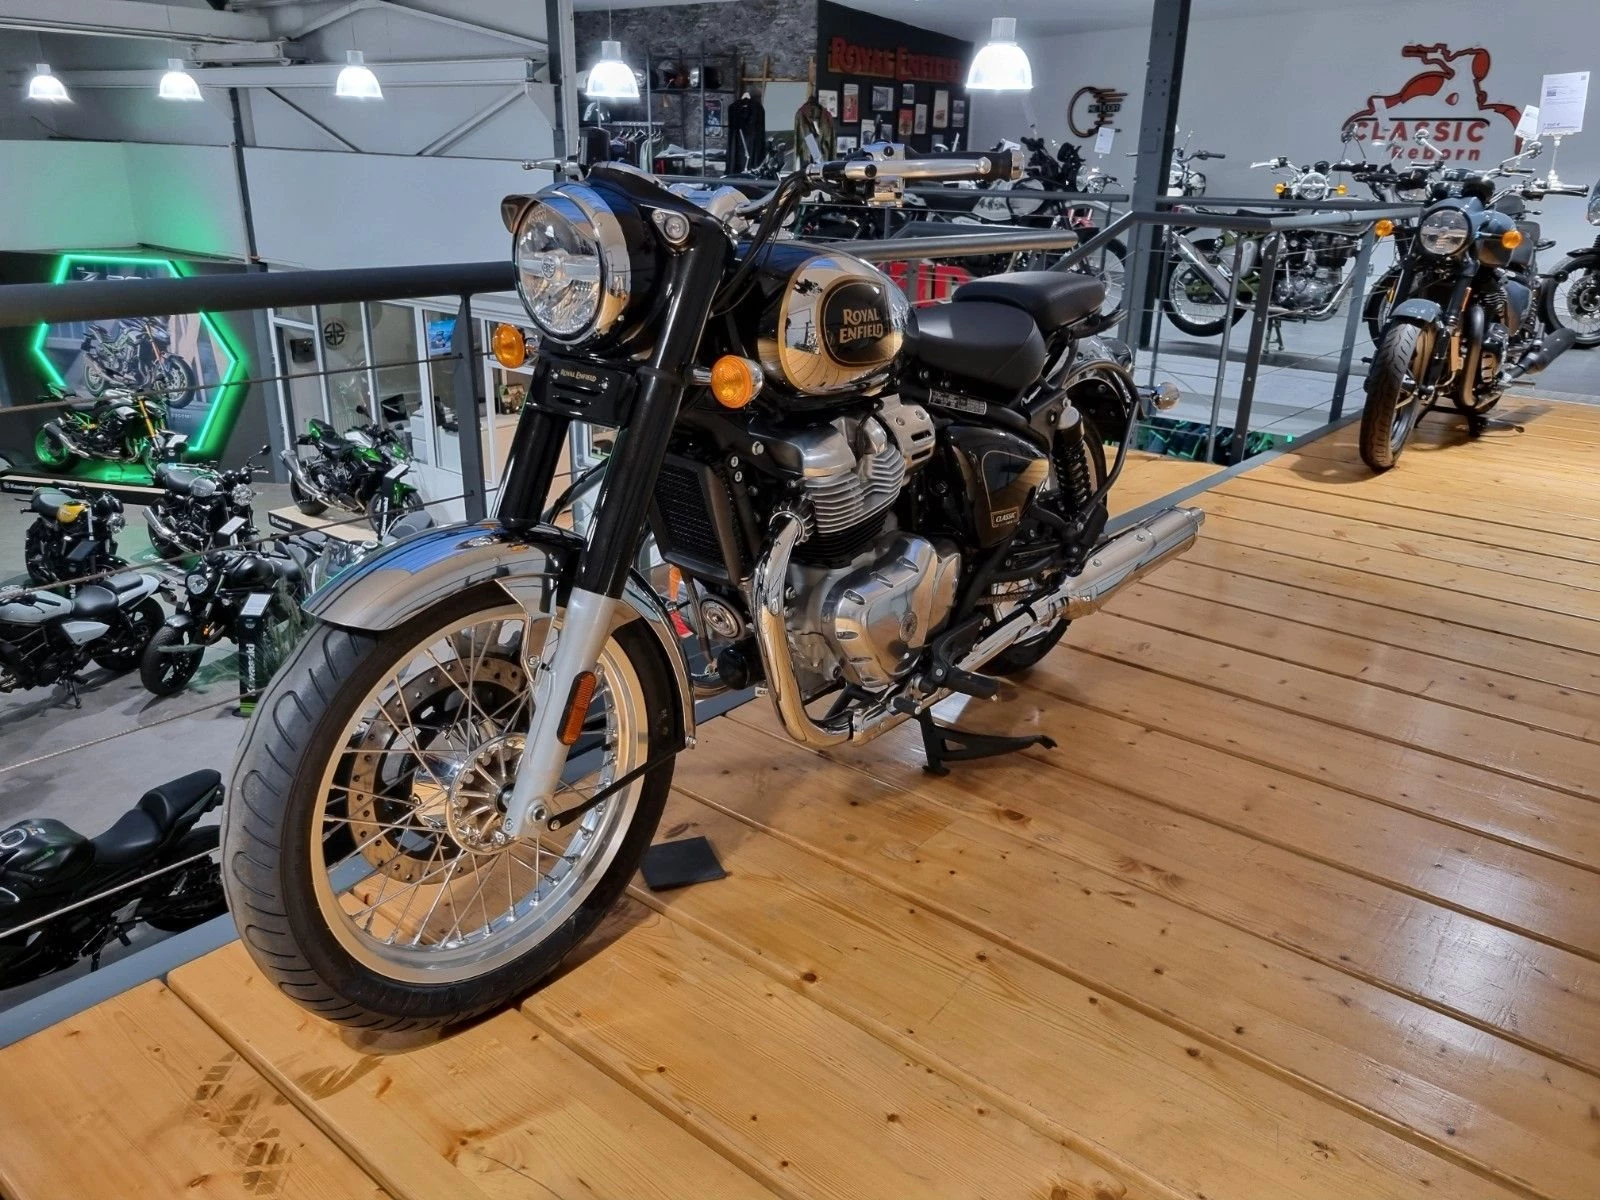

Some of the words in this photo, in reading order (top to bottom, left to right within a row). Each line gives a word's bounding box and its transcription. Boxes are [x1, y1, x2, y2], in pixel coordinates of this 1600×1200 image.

[842, 307, 880, 326] ROYAL
[839, 323, 884, 344] ENFIELD
[560, 369, 575, 378] ROYAL
[576, 371, 597, 382] ENFIELD
